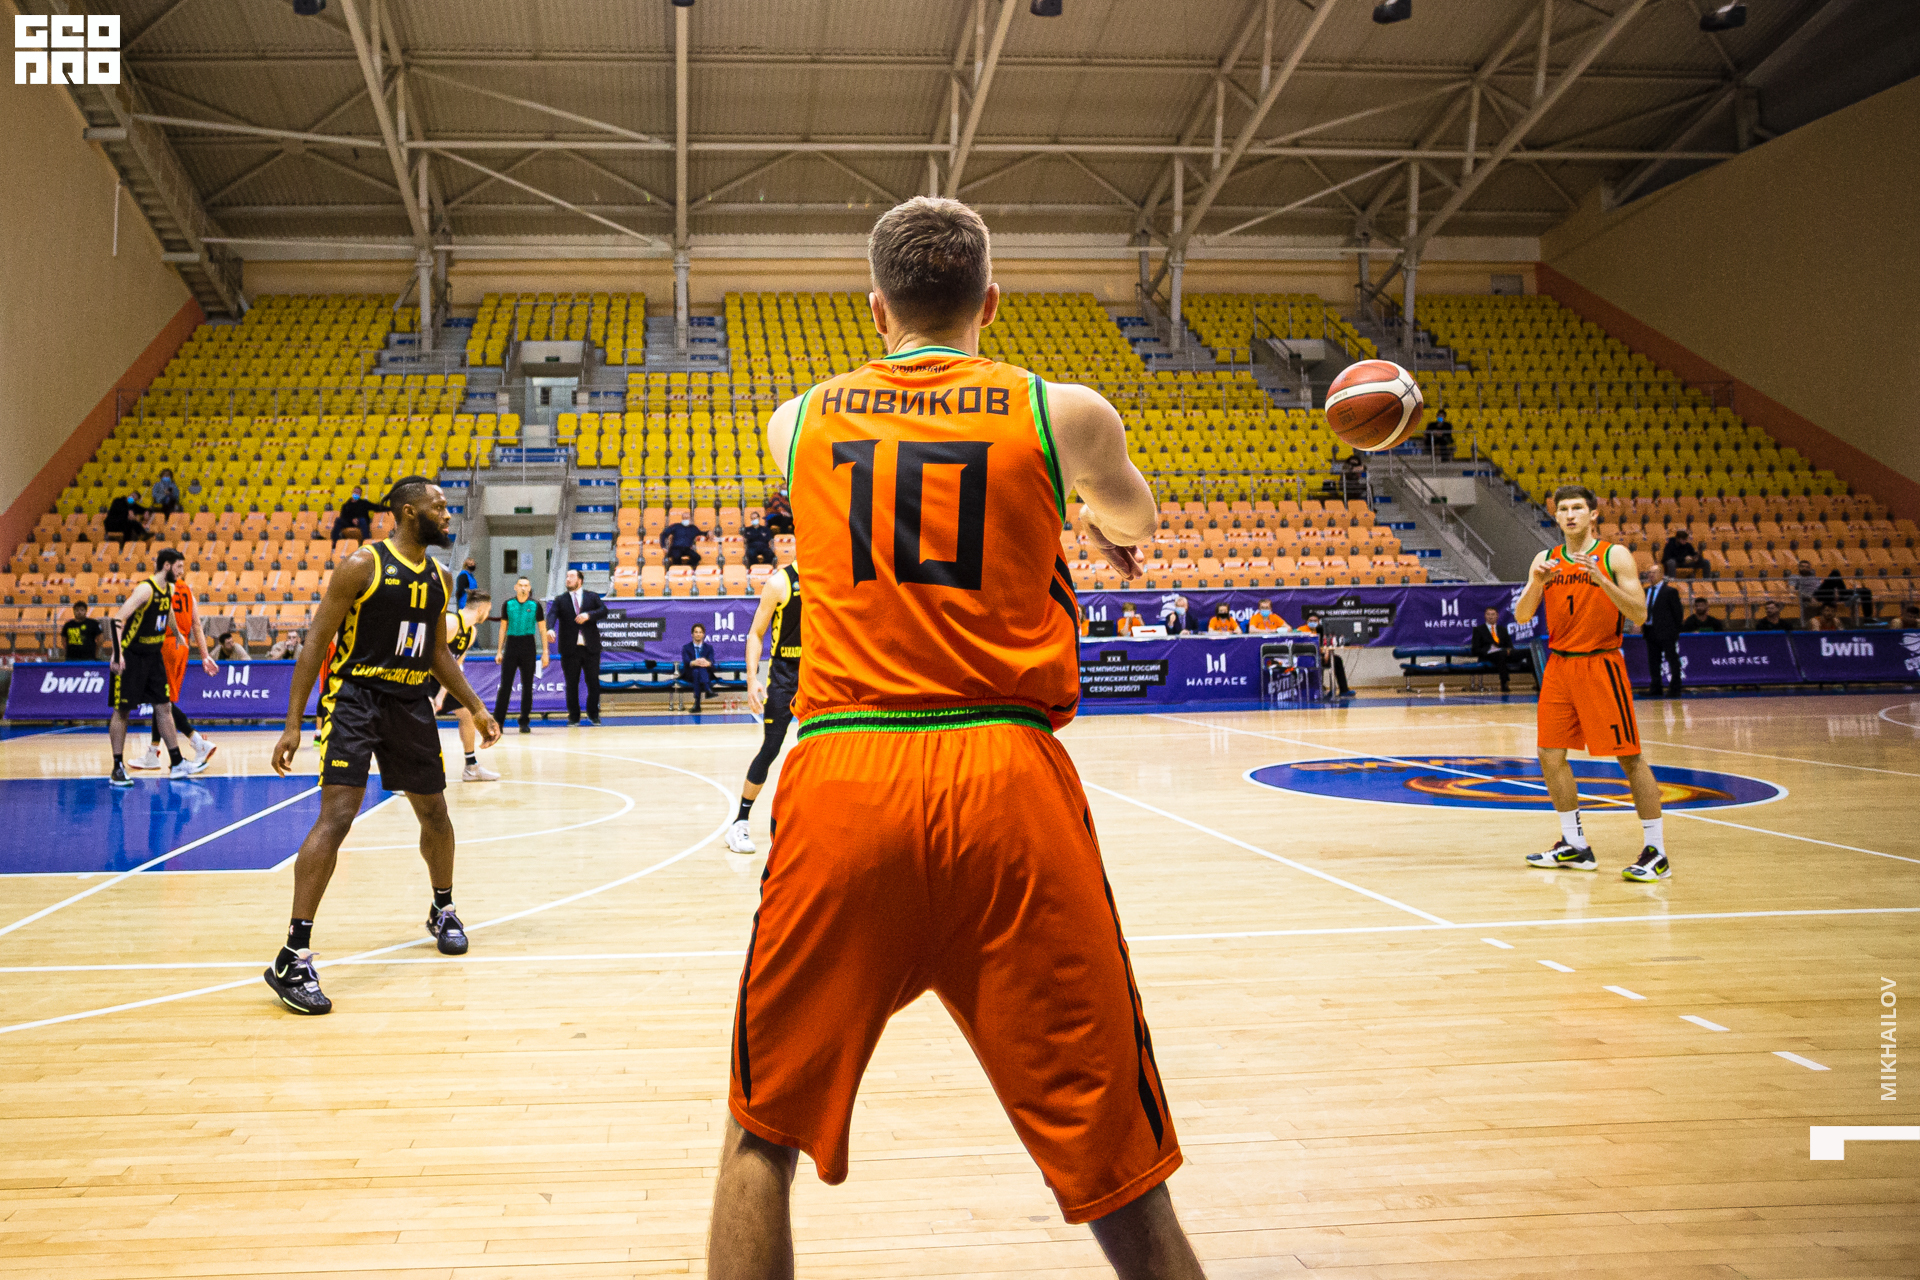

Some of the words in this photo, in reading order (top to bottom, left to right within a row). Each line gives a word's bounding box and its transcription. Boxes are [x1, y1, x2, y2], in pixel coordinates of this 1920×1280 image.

[821, 386, 1010, 416] НОВИКОВ
[831, 439, 995, 591] 10
[159, 597, 170, 611] 23
[408, 580, 428, 609] 11
[1566, 595, 1574, 616] 1
[1425, 619, 1478, 628] WARFACE
[1820, 637, 1875, 657] bwin
[1711, 655, 1770, 666] WARFACE
[40, 671, 105, 693] bwin
[1186, 676, 1248, 686] WARFACE
[202, 689, 270, 699] WARFACE
[1610, 724, 1622, 746] 1
